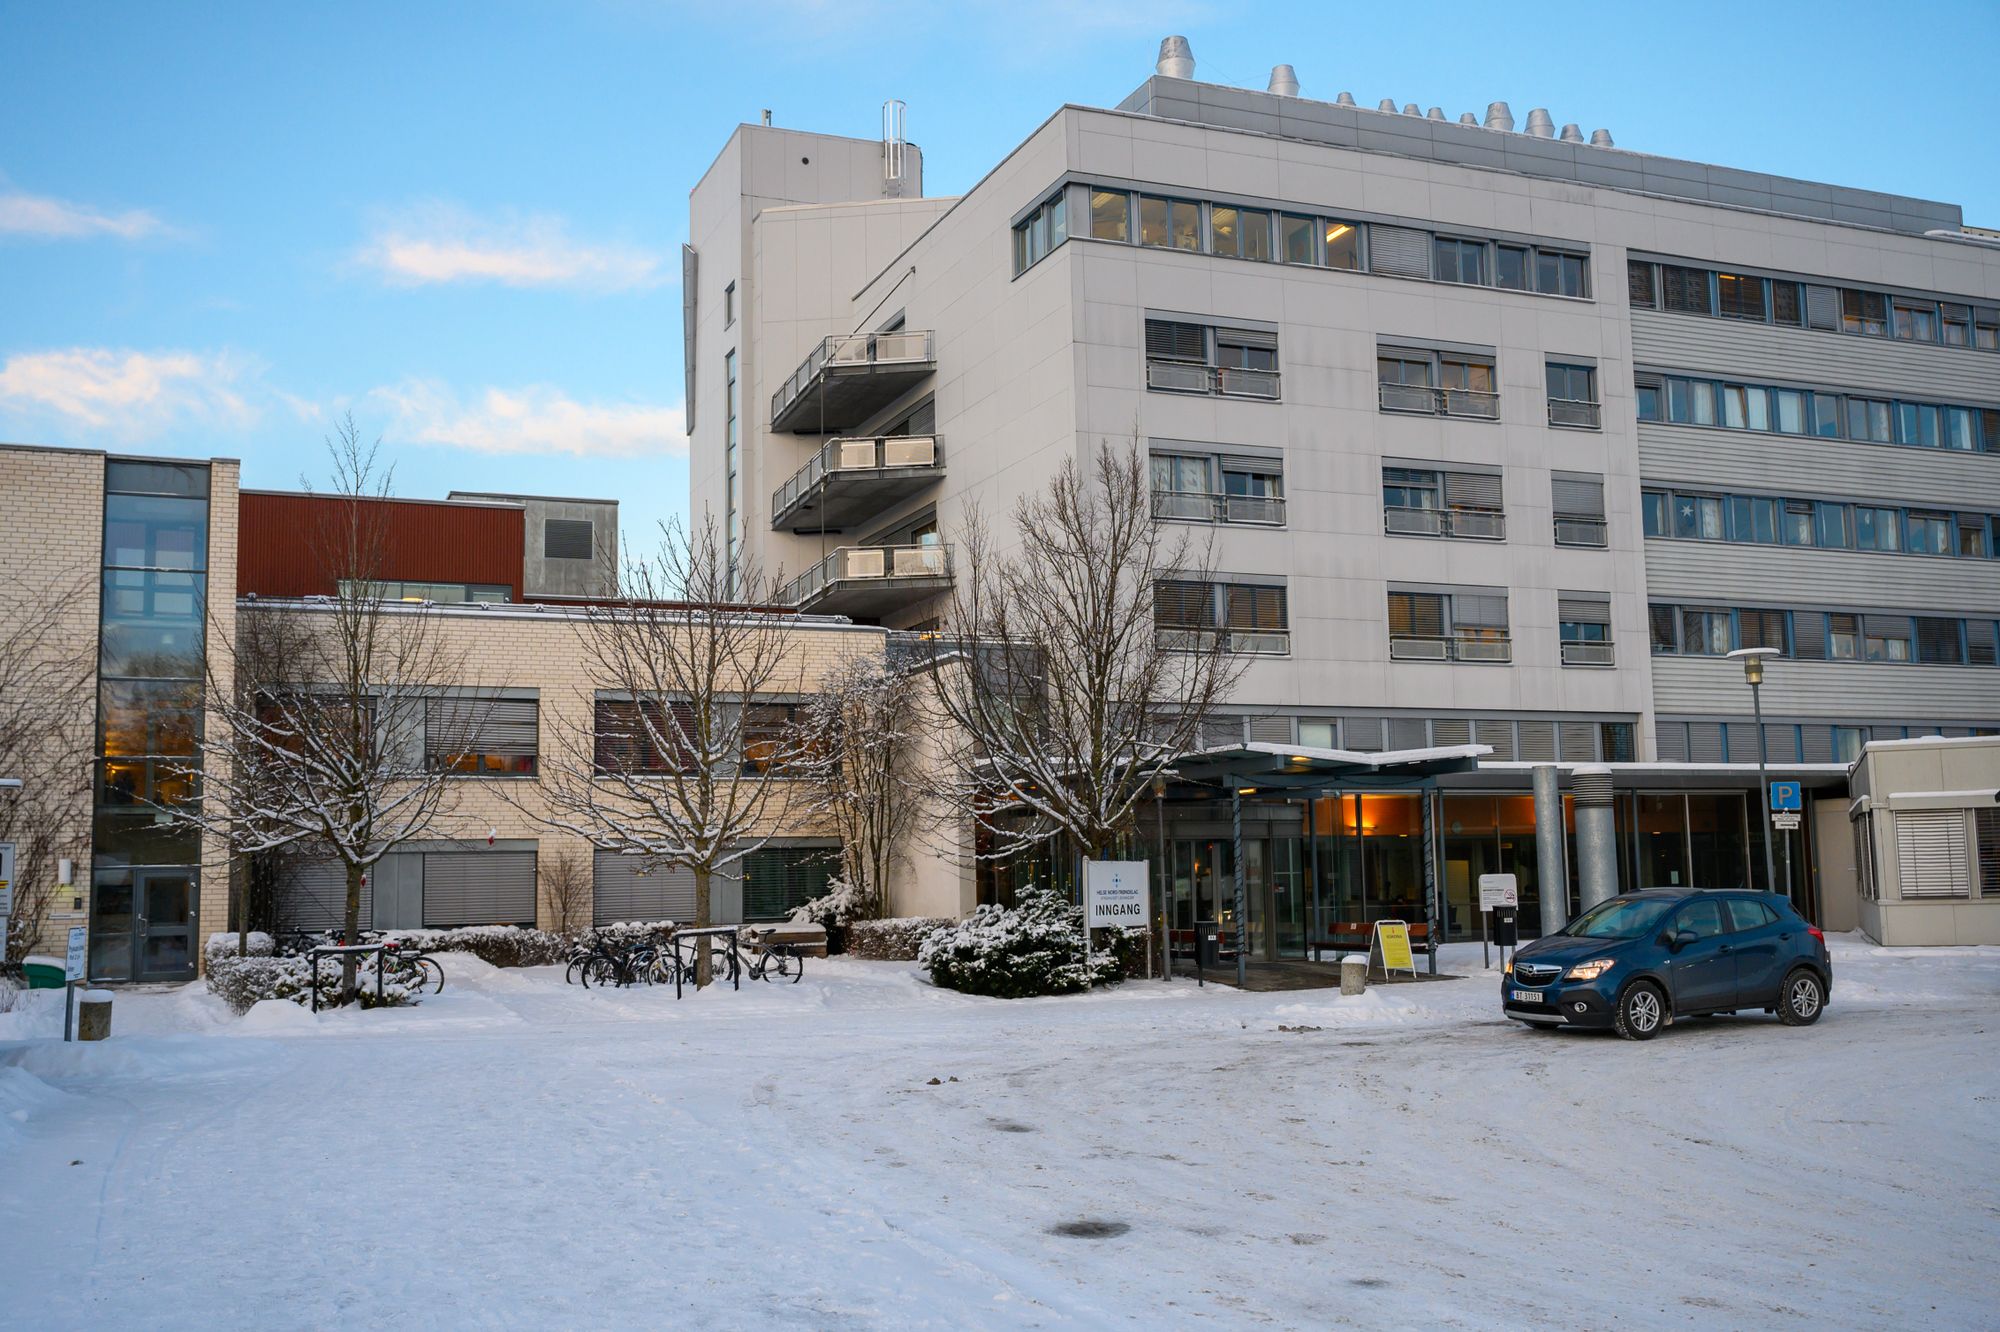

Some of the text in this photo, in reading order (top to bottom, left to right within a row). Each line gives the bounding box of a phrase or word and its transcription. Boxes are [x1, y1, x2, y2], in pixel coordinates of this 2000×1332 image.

[1778, 786, 1792, 805] P
[1095, 903, 1140, 916] INNGANG
[1524, 992, 1540, 1001] 31151
